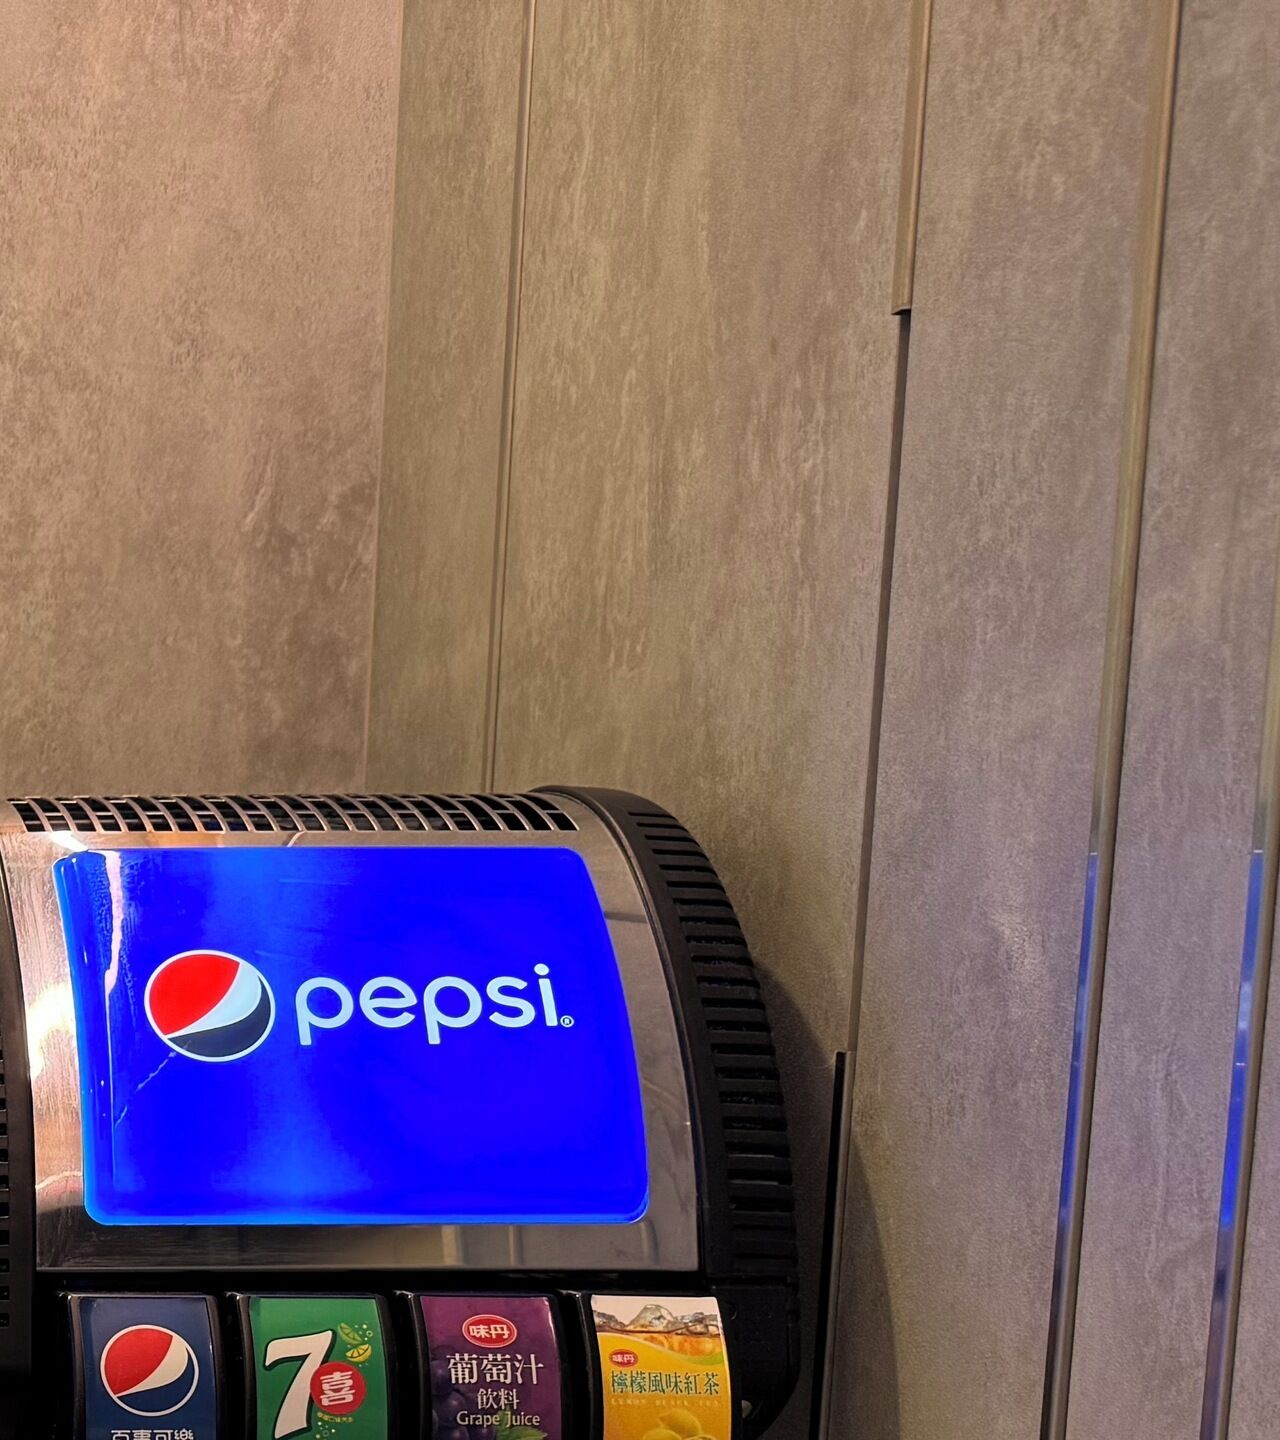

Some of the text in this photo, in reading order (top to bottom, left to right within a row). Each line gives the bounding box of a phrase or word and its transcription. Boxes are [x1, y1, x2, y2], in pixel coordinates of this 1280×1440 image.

[295, 962, 559, 1046] pepsi
[469, 1324, 510, 1339] 味丹
[446, 1353, 544, 1384] 葡萄汁
[611, 1371, 719, 1395] 檸檬風味紅茶
[477, 1388, 520, 1410] 飲料
[456, 1411, 540, 1428] Grape Juice
